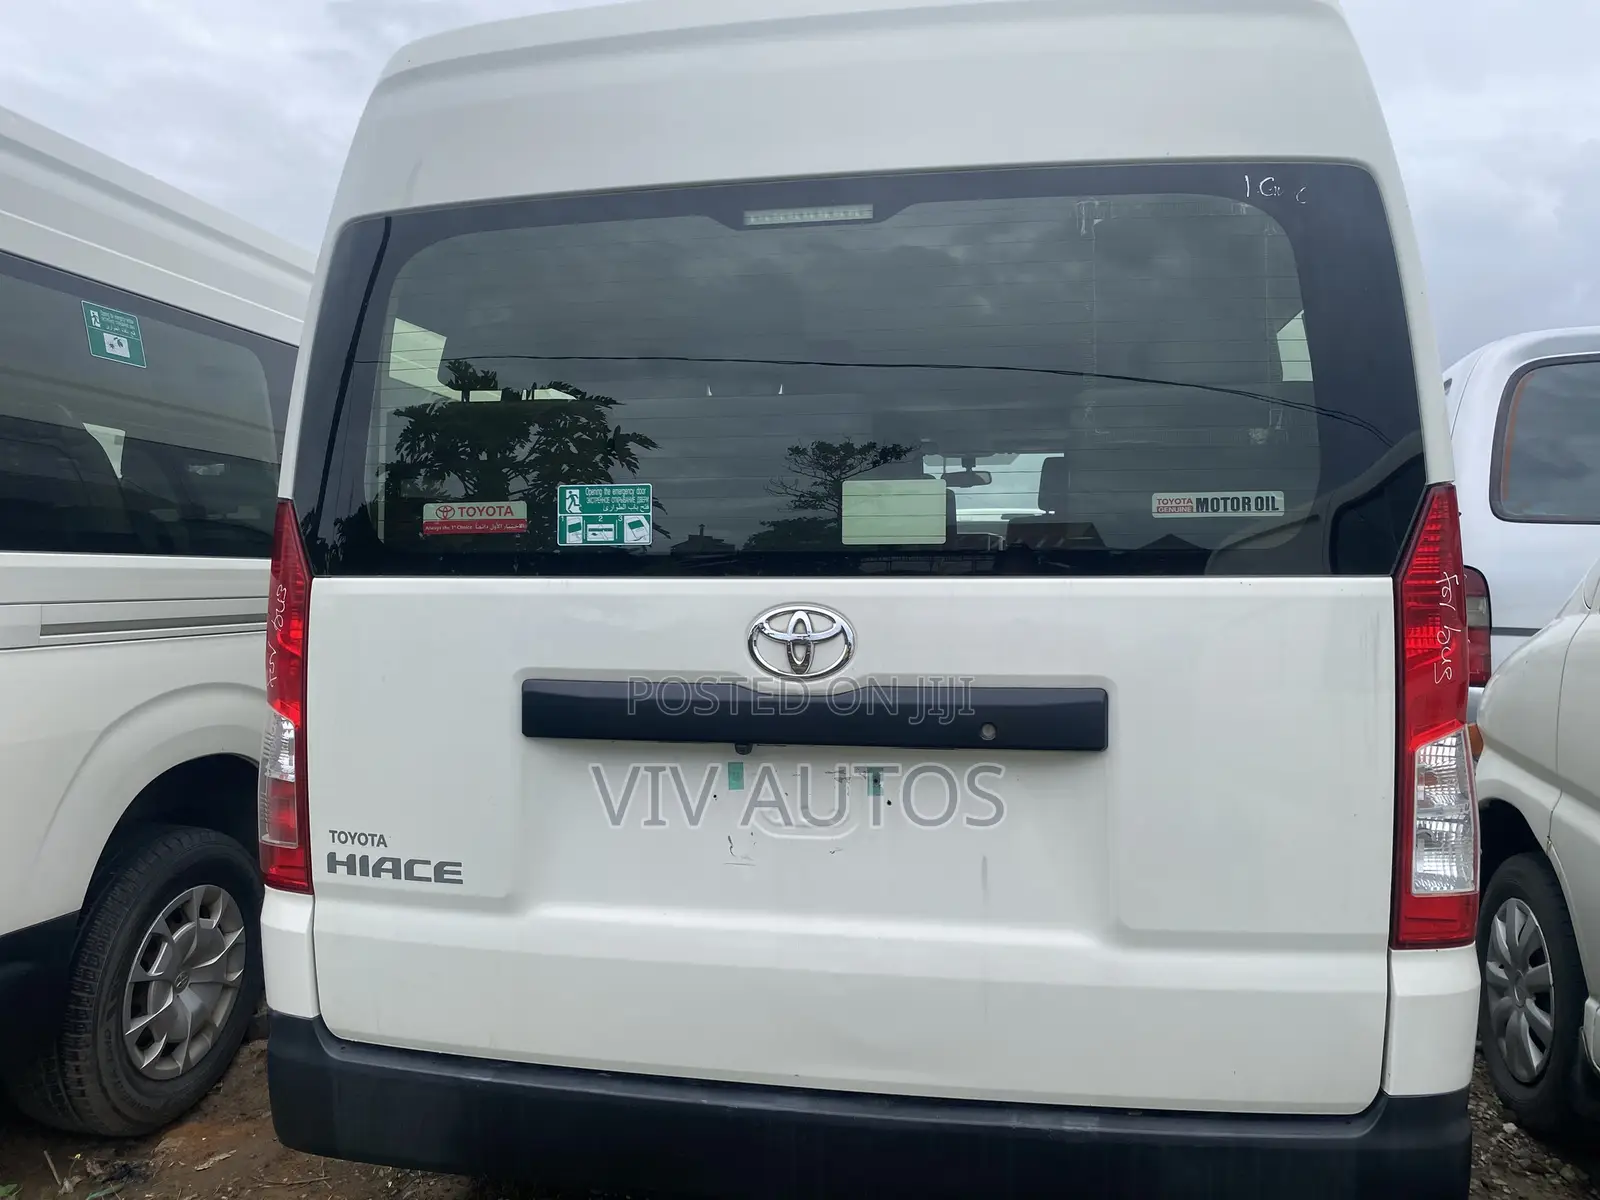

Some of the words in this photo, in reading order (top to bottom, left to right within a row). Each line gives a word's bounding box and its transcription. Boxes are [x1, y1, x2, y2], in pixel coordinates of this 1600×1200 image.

[458, 505, 514, 518] TOYOTA
[1157, 505, 1193, 513] GENUINE
[1196, 496, 1252, 513] MOTOR
[1254, 495, 1280, 511] OIL
[1434, 624, 1461, 685] bus
[328, 829, 389, 848] TOYOTA
[326, 851, 464, 885] HIACE
